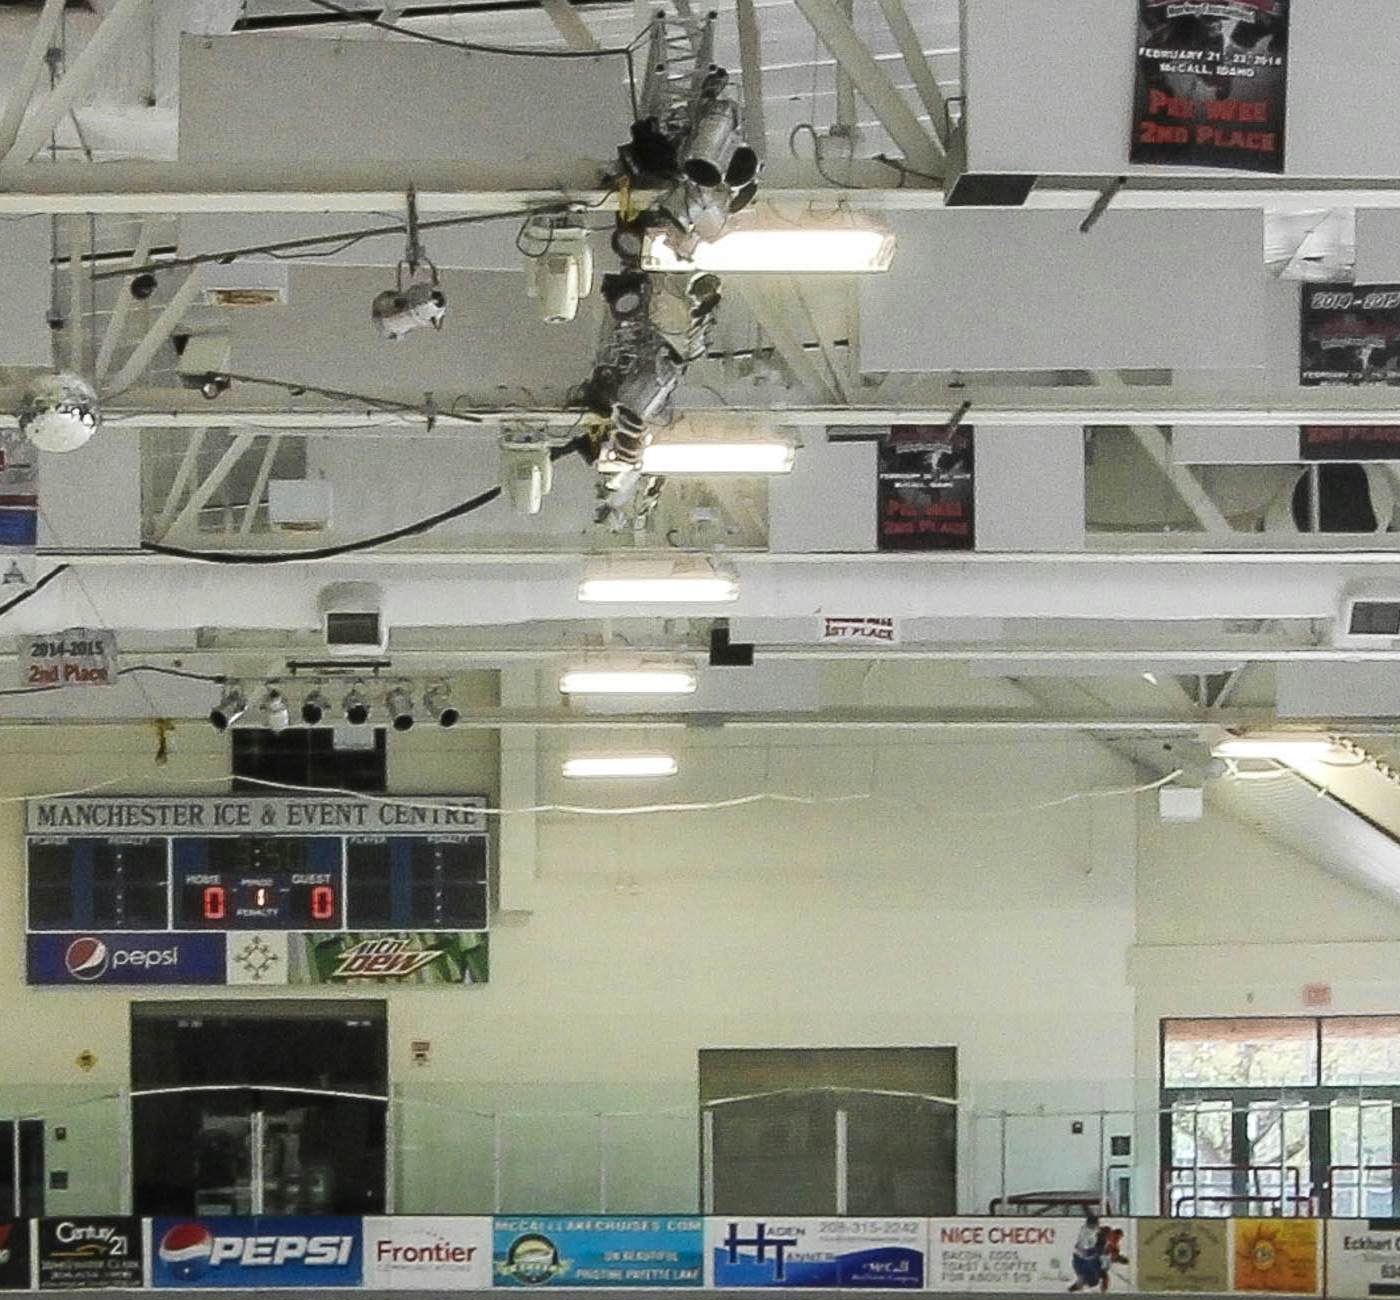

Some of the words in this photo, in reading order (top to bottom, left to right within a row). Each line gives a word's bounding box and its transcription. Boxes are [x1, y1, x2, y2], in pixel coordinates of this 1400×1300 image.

[1138, 47, 1204, 60] FEBRUARY
[1216, 66, 1255, 77] IDAHO
[31, 641, 104, 657] 2014-2015
[28, 665, 60, 682] 2nd
[64, 664, 108, 682] Place
[37, 804, 204, 826] MANCHESTER
[213, 804, 250, 825] ICE
[261, 804, 276, 825] &
[287, 804, 368, 825] EVENT
[379, 803, 478, 825] CENTRE
[292, 873, 331, 884] GUEST
[204, 886, 225, 919] 0
[312, 886, 334, 919] 0
[112, 946, 178, 969] pepsi
[56, 1222, 116, 1243] Century
[940, 1227, 983, 1243] NICE
[988, 1227, 1056, 1244] CHECK!
[109, 1236, 129, 1256] 21
[208, 1236, 353, 1266] PEPSI
[376, 1240, 477, 1262] Frontier
[1344, 1236, 1391, 1250] Eckhart
[969, 1272, 1009, 1281] ABOUT
